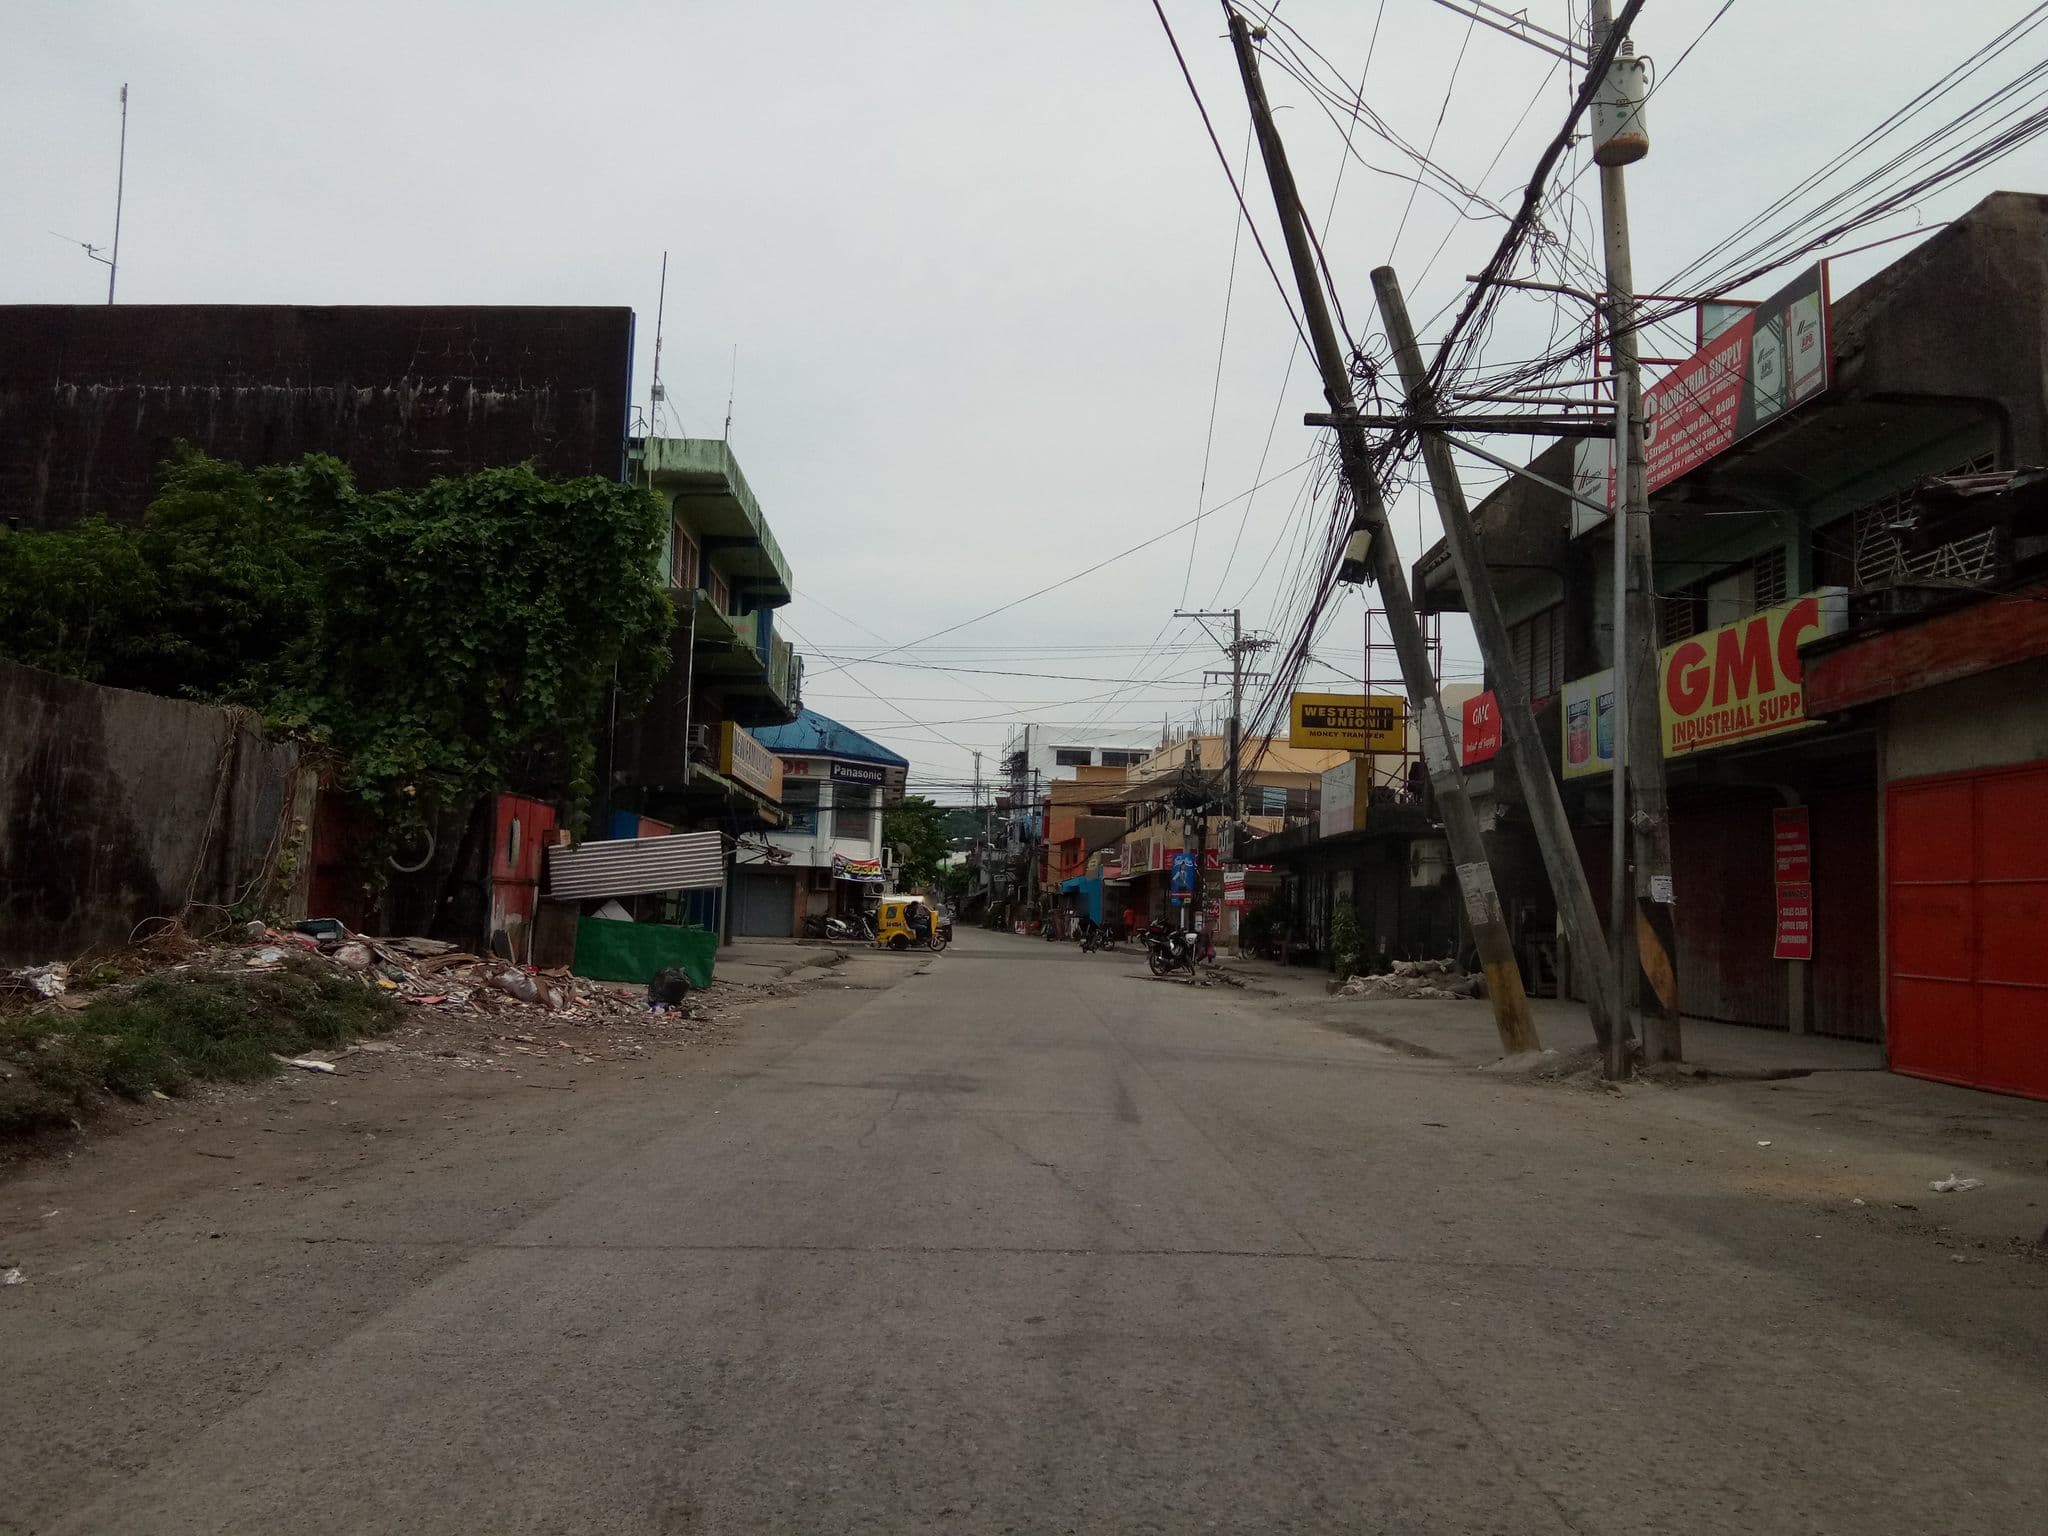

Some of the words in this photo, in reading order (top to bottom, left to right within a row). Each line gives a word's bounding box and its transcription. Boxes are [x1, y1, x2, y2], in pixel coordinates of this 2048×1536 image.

[1660, 365, 1707, 415] INDUSTRIAL
[1709, 338, 1742, 380] SUPPLY
[1666, 597, 1819, 716] GMC
[1304, 706, 1376, 718] WESTERN
[1326, 717, 1376, 728] UNION
[1672, 704, 1754, 744] INDUSTRIAL
[1309, 730, 1339, 738] MONEY
[1342, 731, 1385, 739] TRANFER
[833, 763, 882, 780] Panasonic
